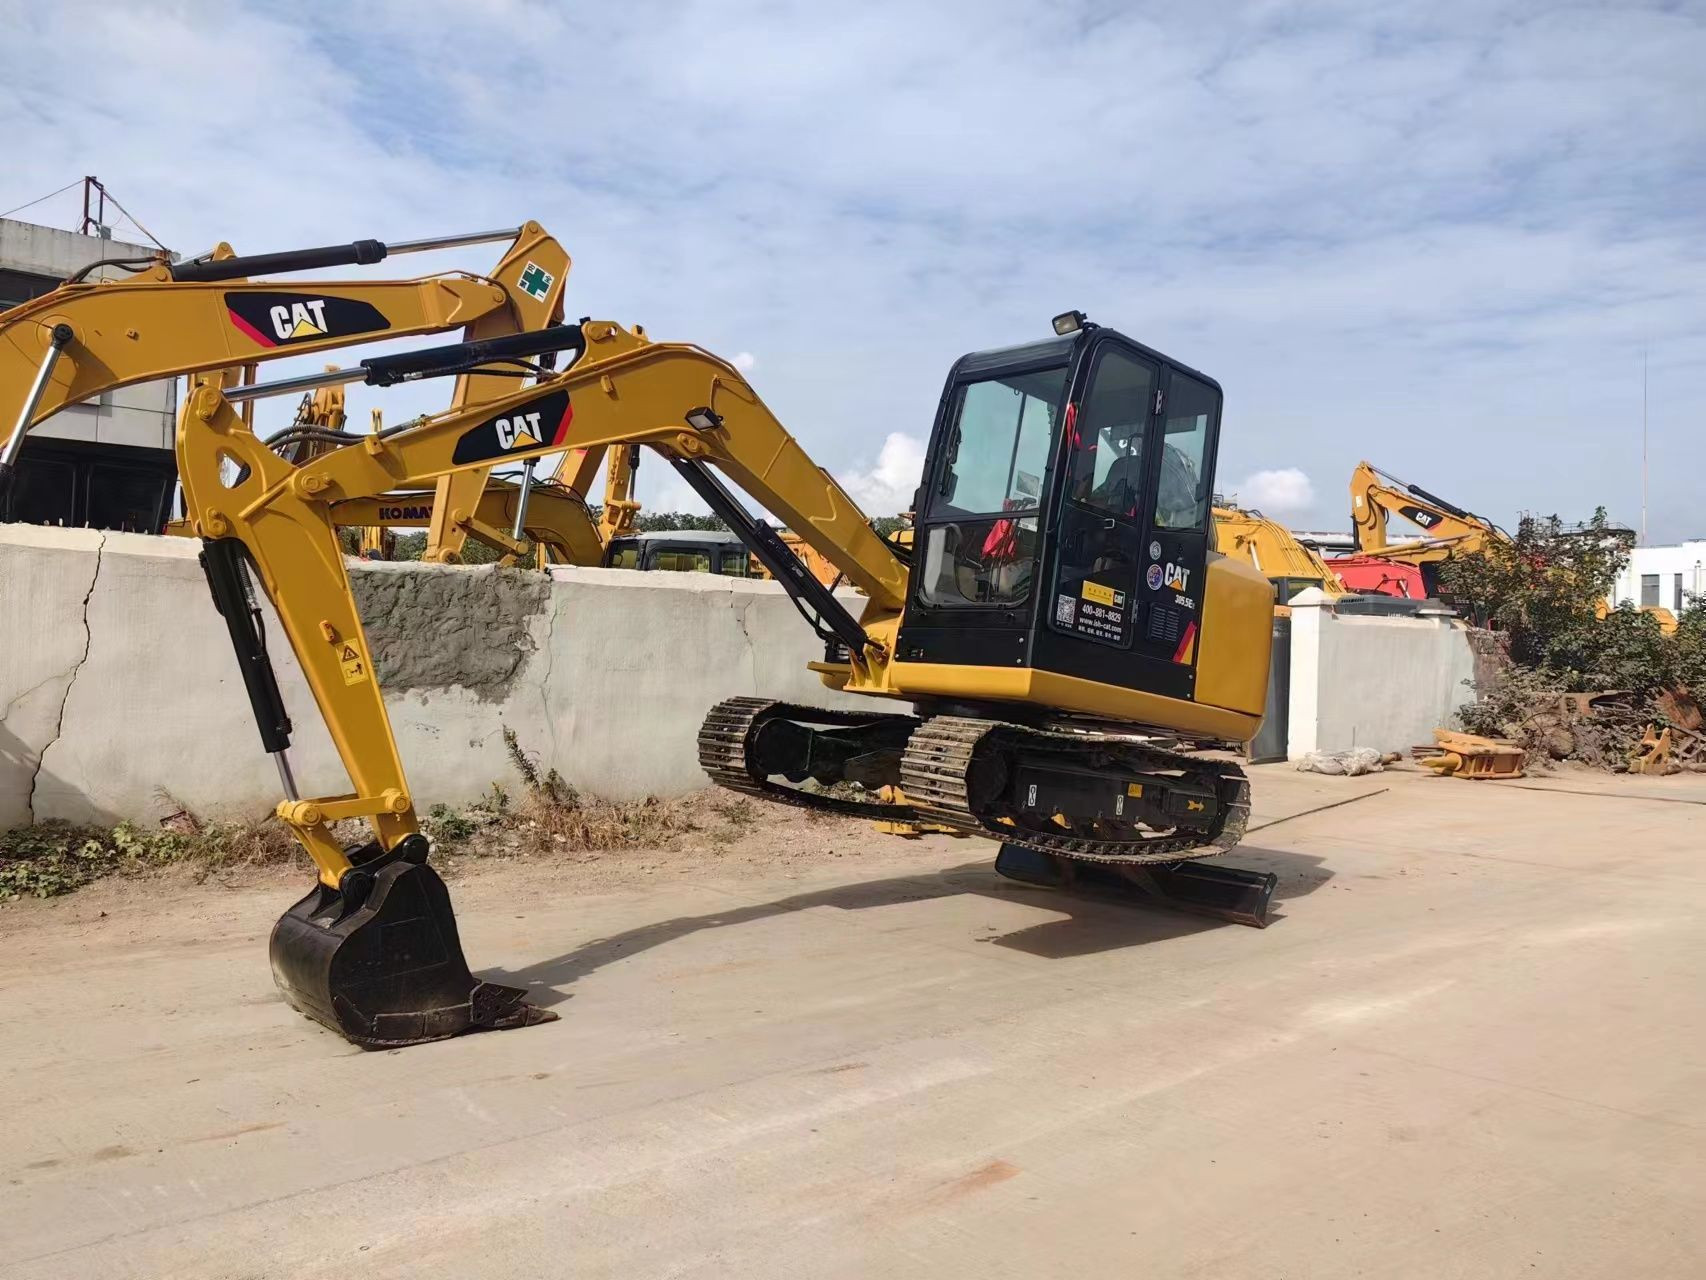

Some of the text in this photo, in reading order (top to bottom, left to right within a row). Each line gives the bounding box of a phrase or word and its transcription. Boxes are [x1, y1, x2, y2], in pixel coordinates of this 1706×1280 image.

[270, 300, 328, 339] CAT
[495, 412, 543, 449] CAT
[1415, 512, 1432, 526] CAT
[1164, 562, 1190, 592] CAT
